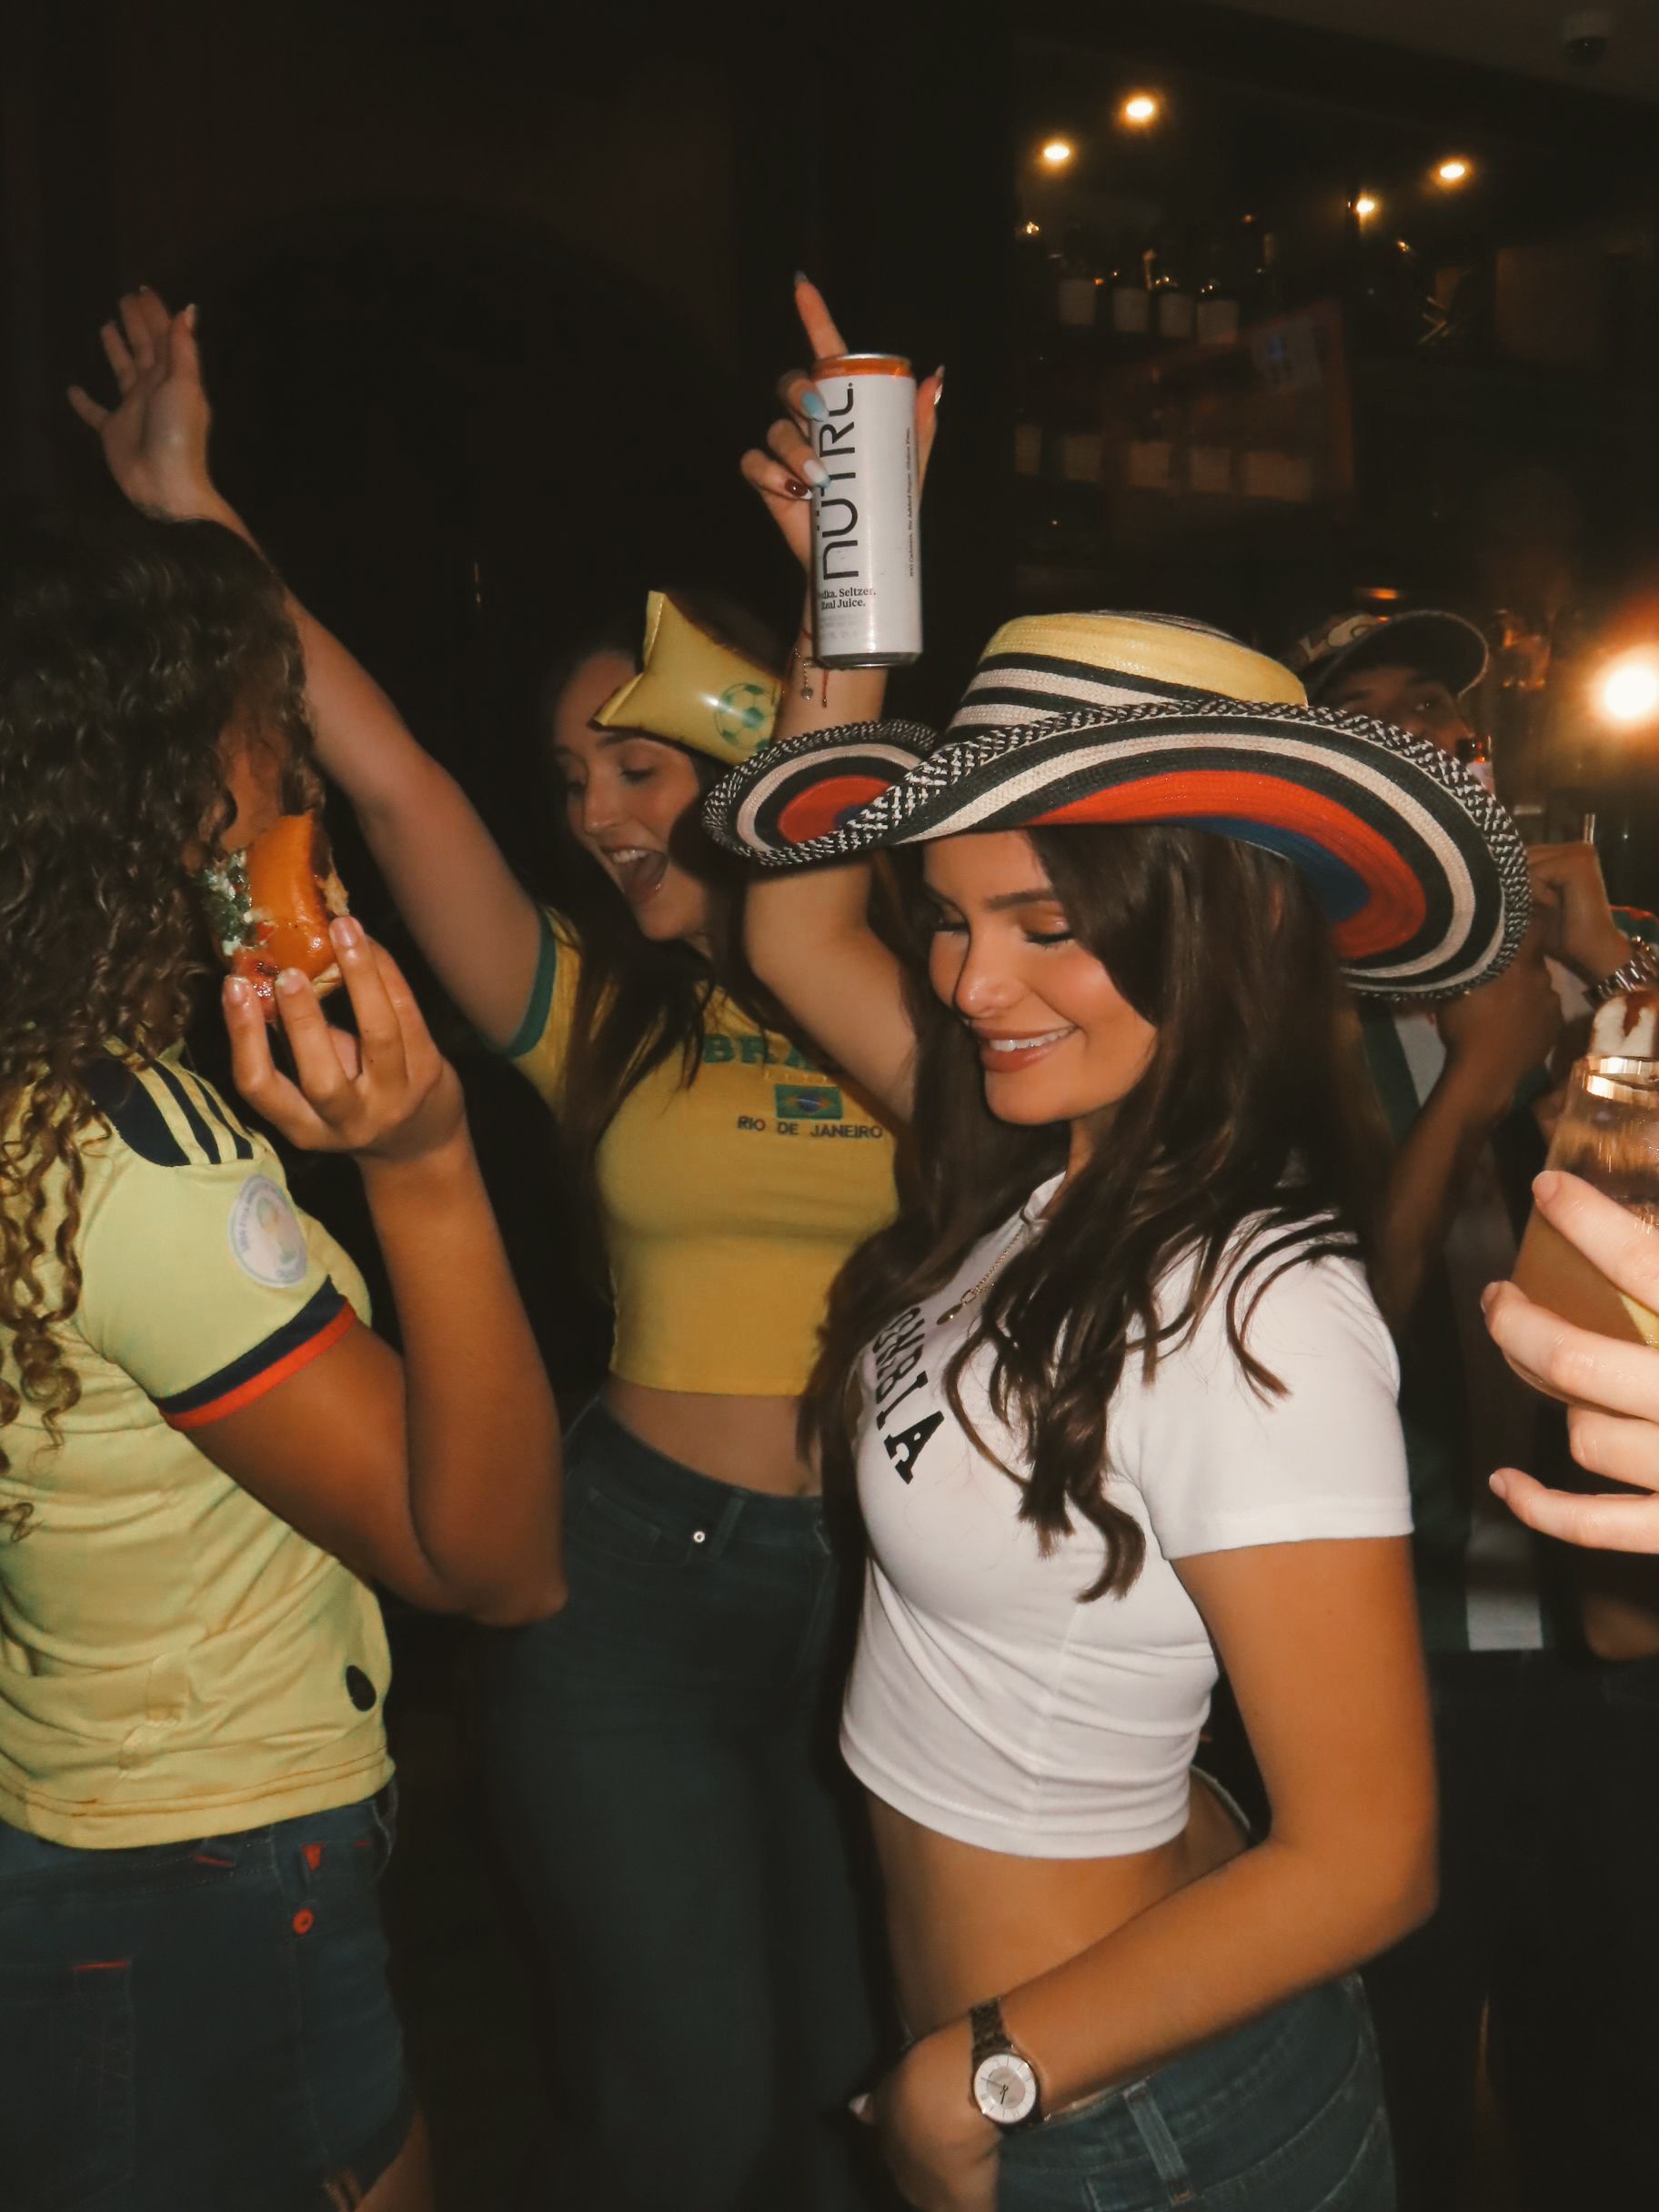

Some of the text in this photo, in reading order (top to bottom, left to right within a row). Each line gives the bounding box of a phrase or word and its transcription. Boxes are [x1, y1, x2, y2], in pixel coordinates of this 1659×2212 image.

[839, 587, 876, 598] Seltzer.
[837, 598, 866, 608] Juice.
[738, 1115, 883, 1139] RIO DE JANEIRO
